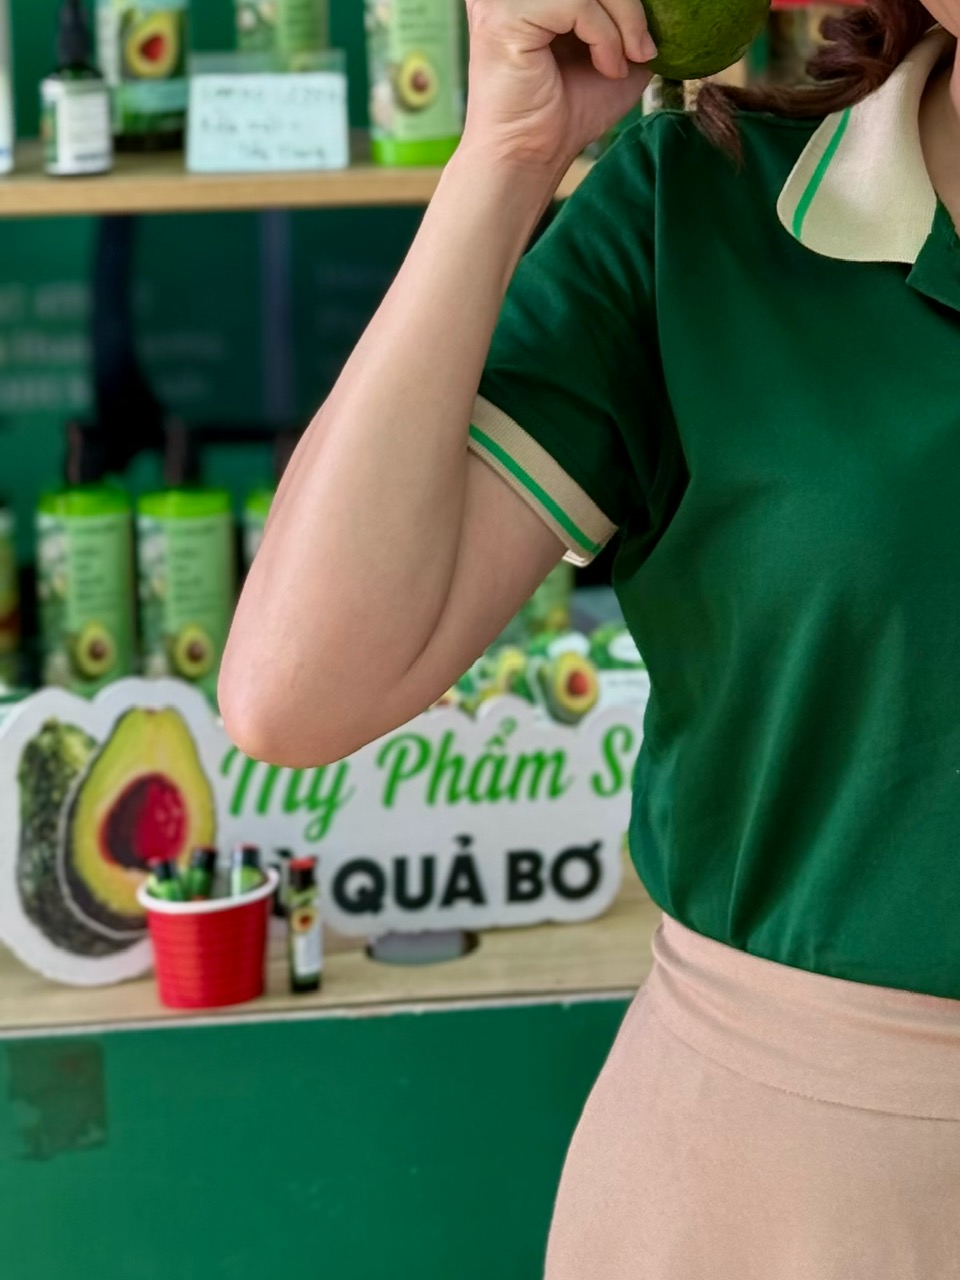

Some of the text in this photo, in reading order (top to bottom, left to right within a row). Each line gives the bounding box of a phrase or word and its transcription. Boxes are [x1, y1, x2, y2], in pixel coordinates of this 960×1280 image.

[376, 717, 572, 810] Phẩm
[331, 833, 487, 915] QUẢ
[505, 839, 604, 904] BƠ
